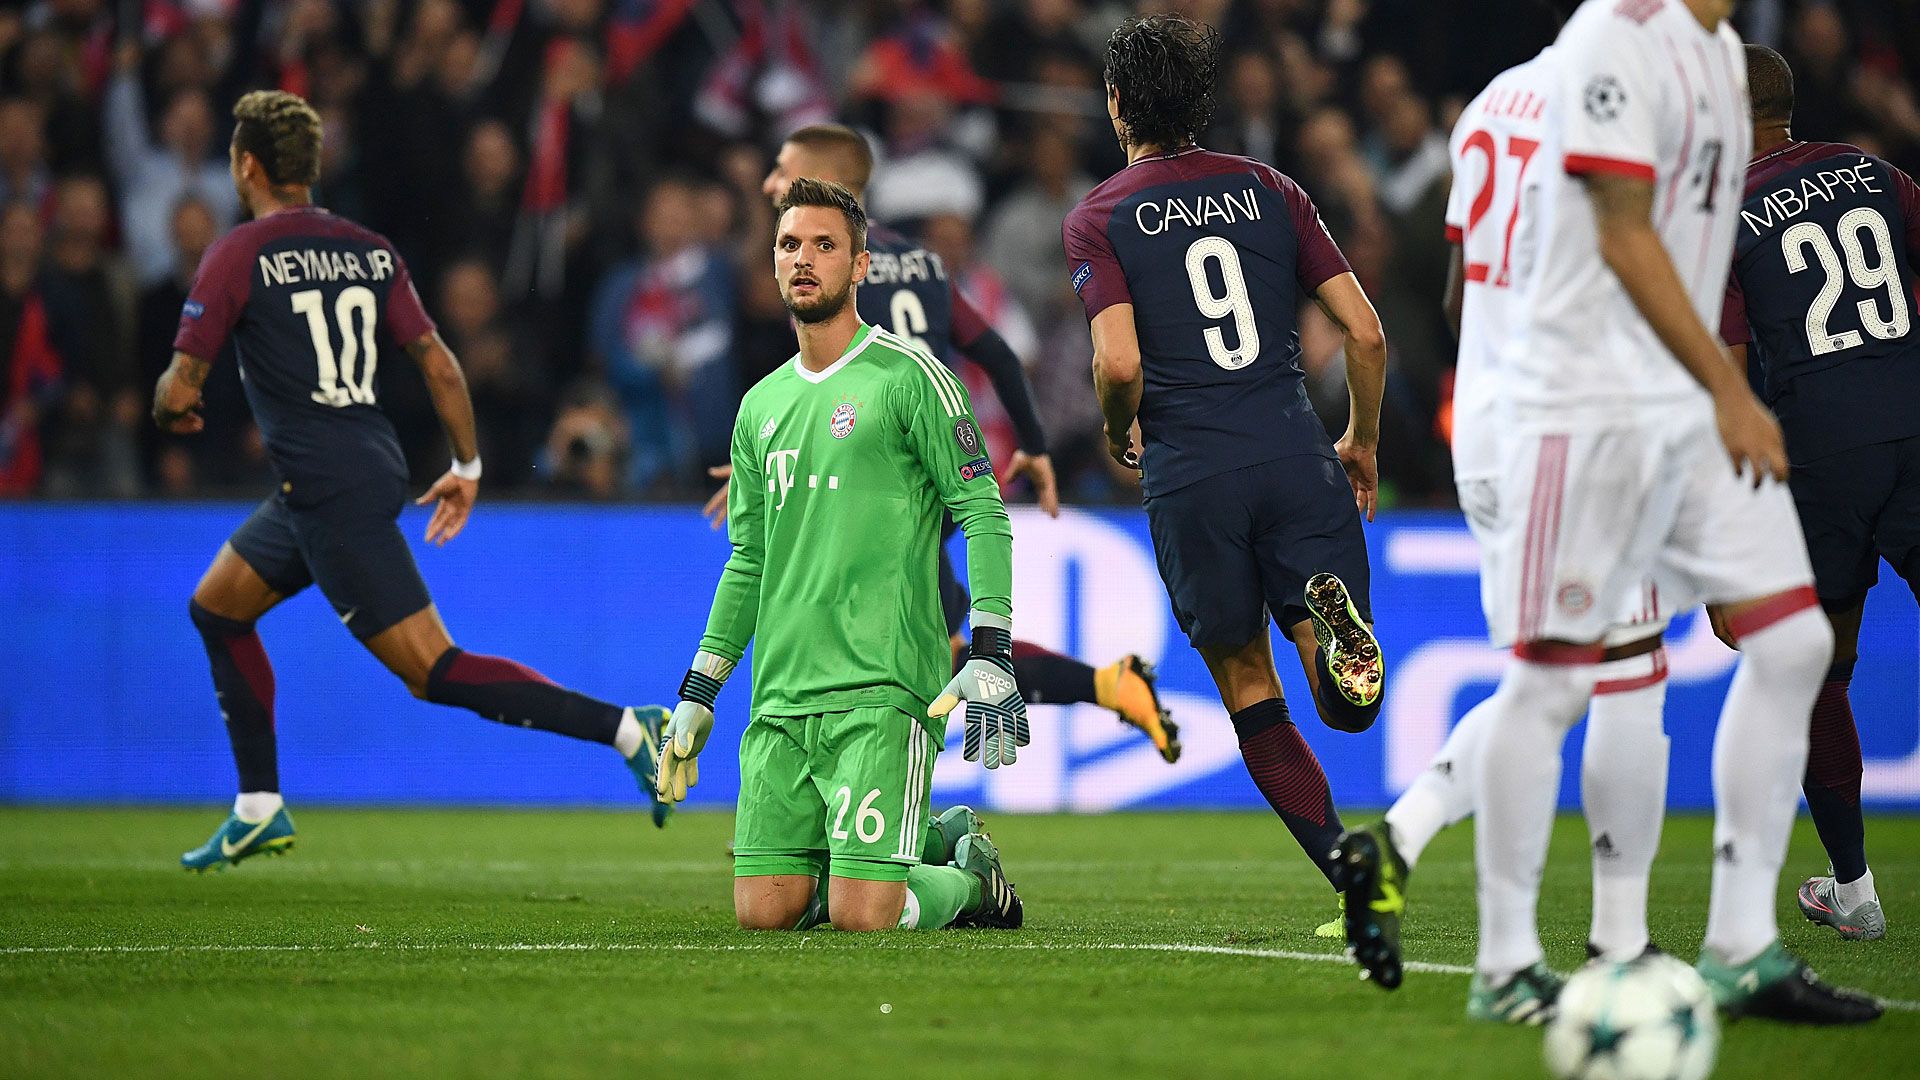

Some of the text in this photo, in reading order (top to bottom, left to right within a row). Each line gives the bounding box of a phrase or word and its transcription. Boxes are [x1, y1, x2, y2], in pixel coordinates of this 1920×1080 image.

[1135, 188, 1261, 235] CAVANI
[1460, 130, 1540, 288] 27
[1740, 157, 1883, 236] MBAPPÉ
[259, 248, 395, 287] NEYMAR JR
[1781, 207, 1911, 356] 29
[1185, 236, 1260, 371] 9
[290, 285, 378, 408] 10
[966, 435, 973, 446] 5
[973, 668, 1012, 689] adidas
[831, 785, 885, 844] 26
